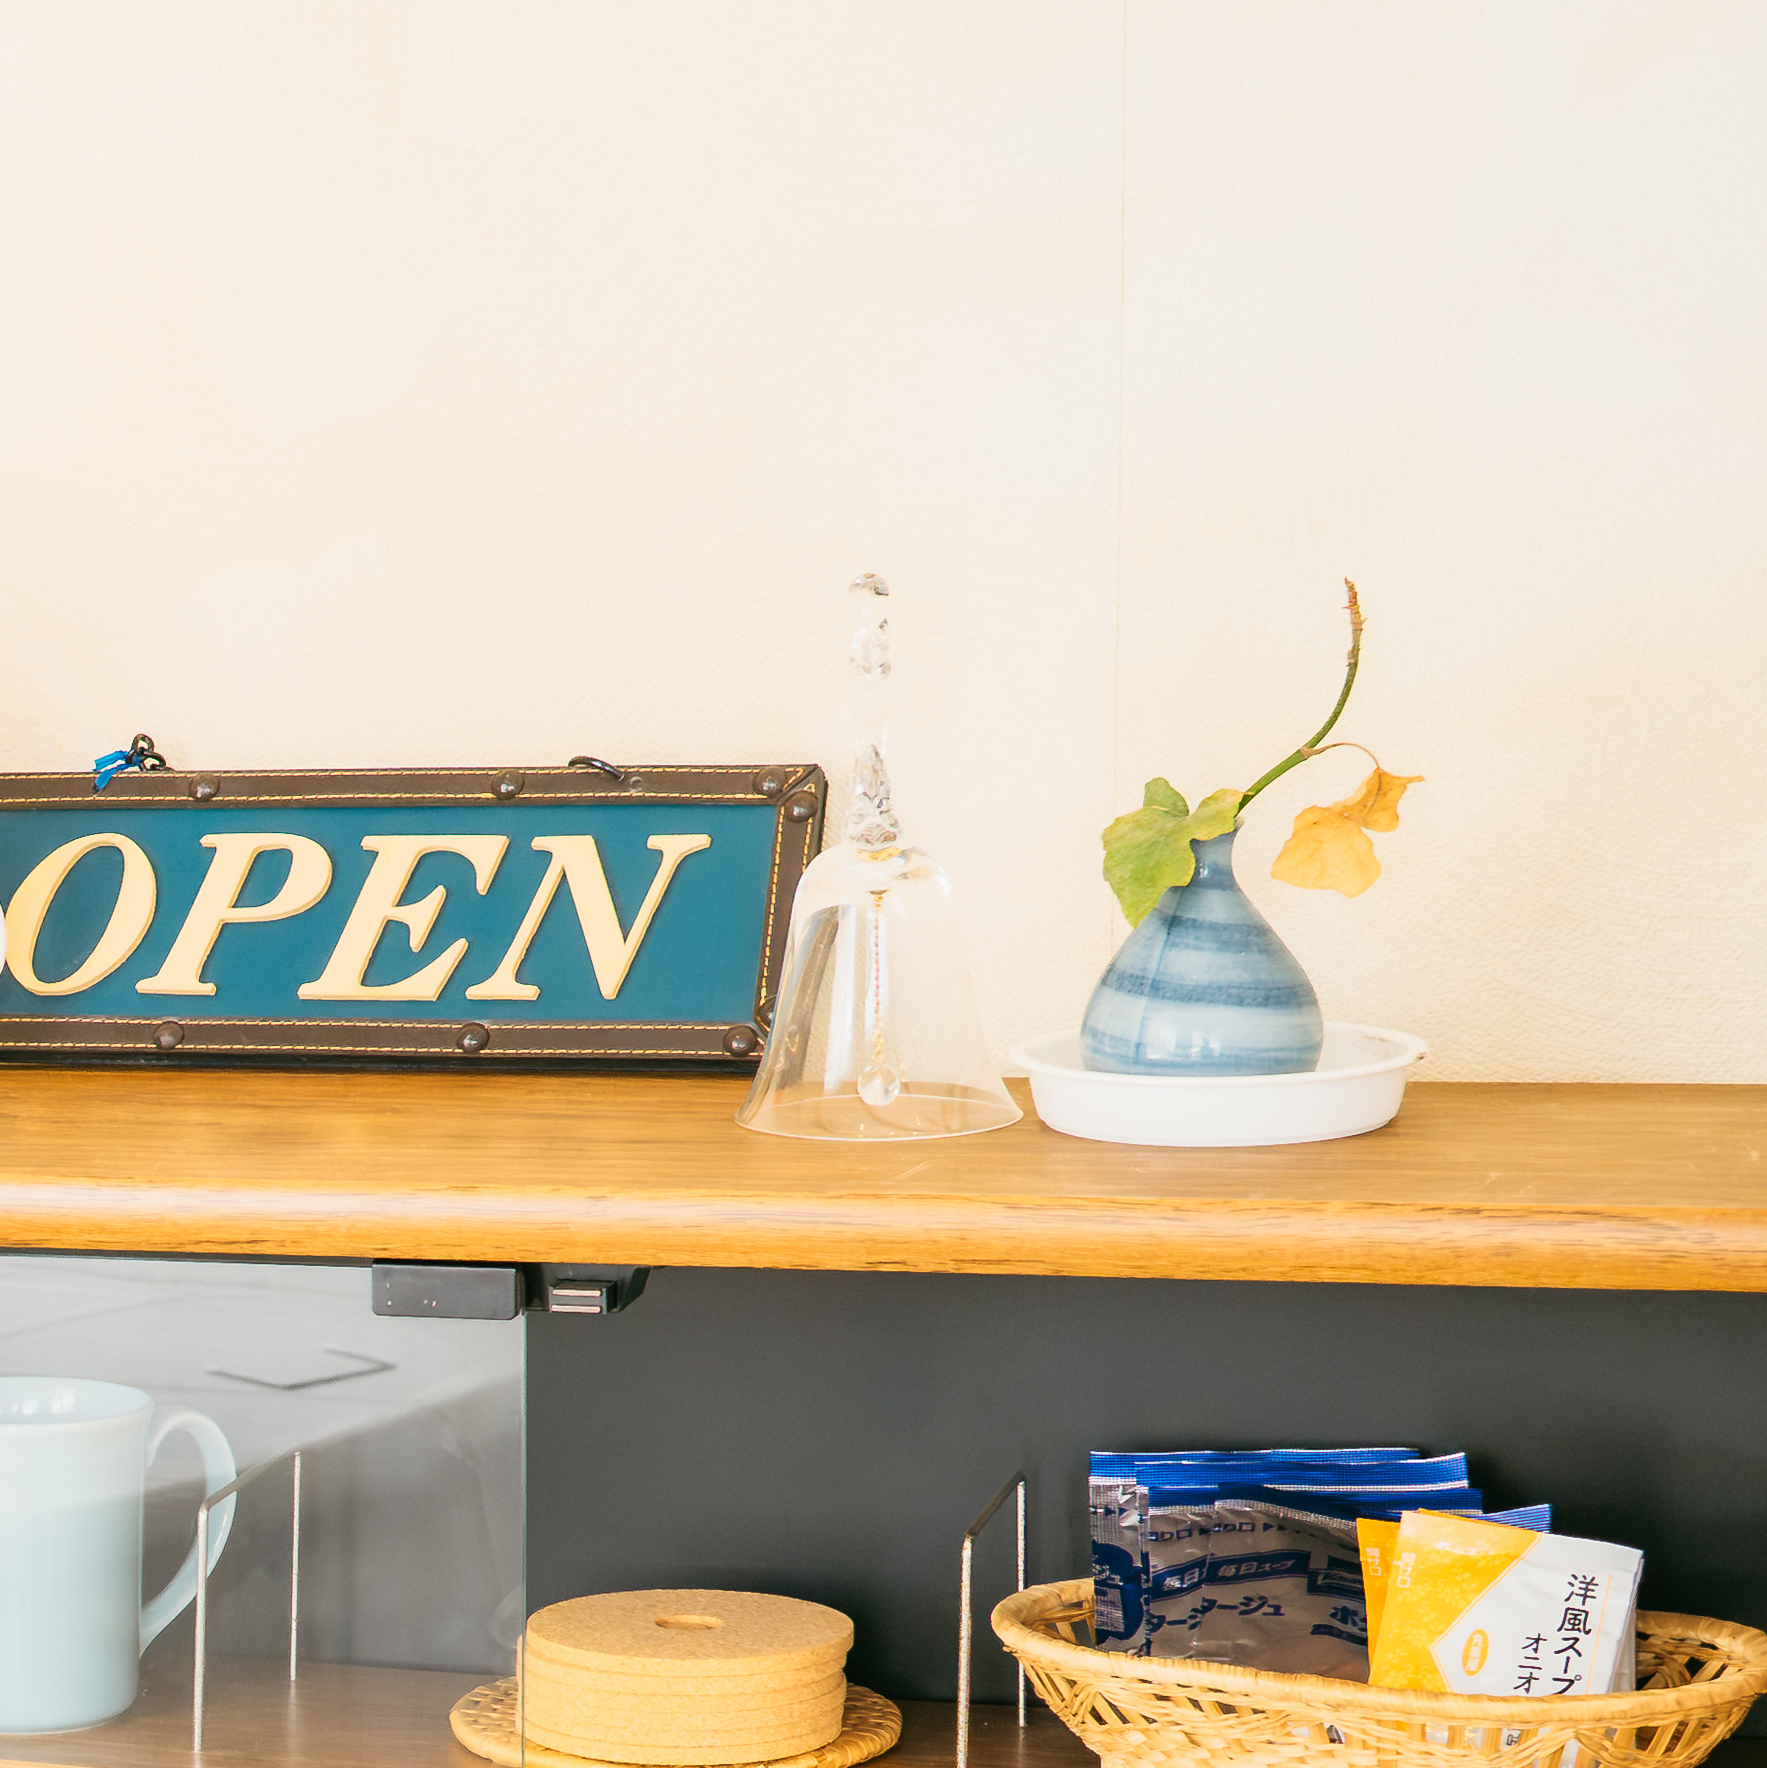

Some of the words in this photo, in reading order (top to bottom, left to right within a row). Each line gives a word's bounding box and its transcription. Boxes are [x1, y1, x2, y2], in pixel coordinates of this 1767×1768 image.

[4, 832, 712, 1001] OPEN
[1513, 1633, 1548, 1694] オニオ
[1552, 1573, 1599, 1695] 洋風スープ
